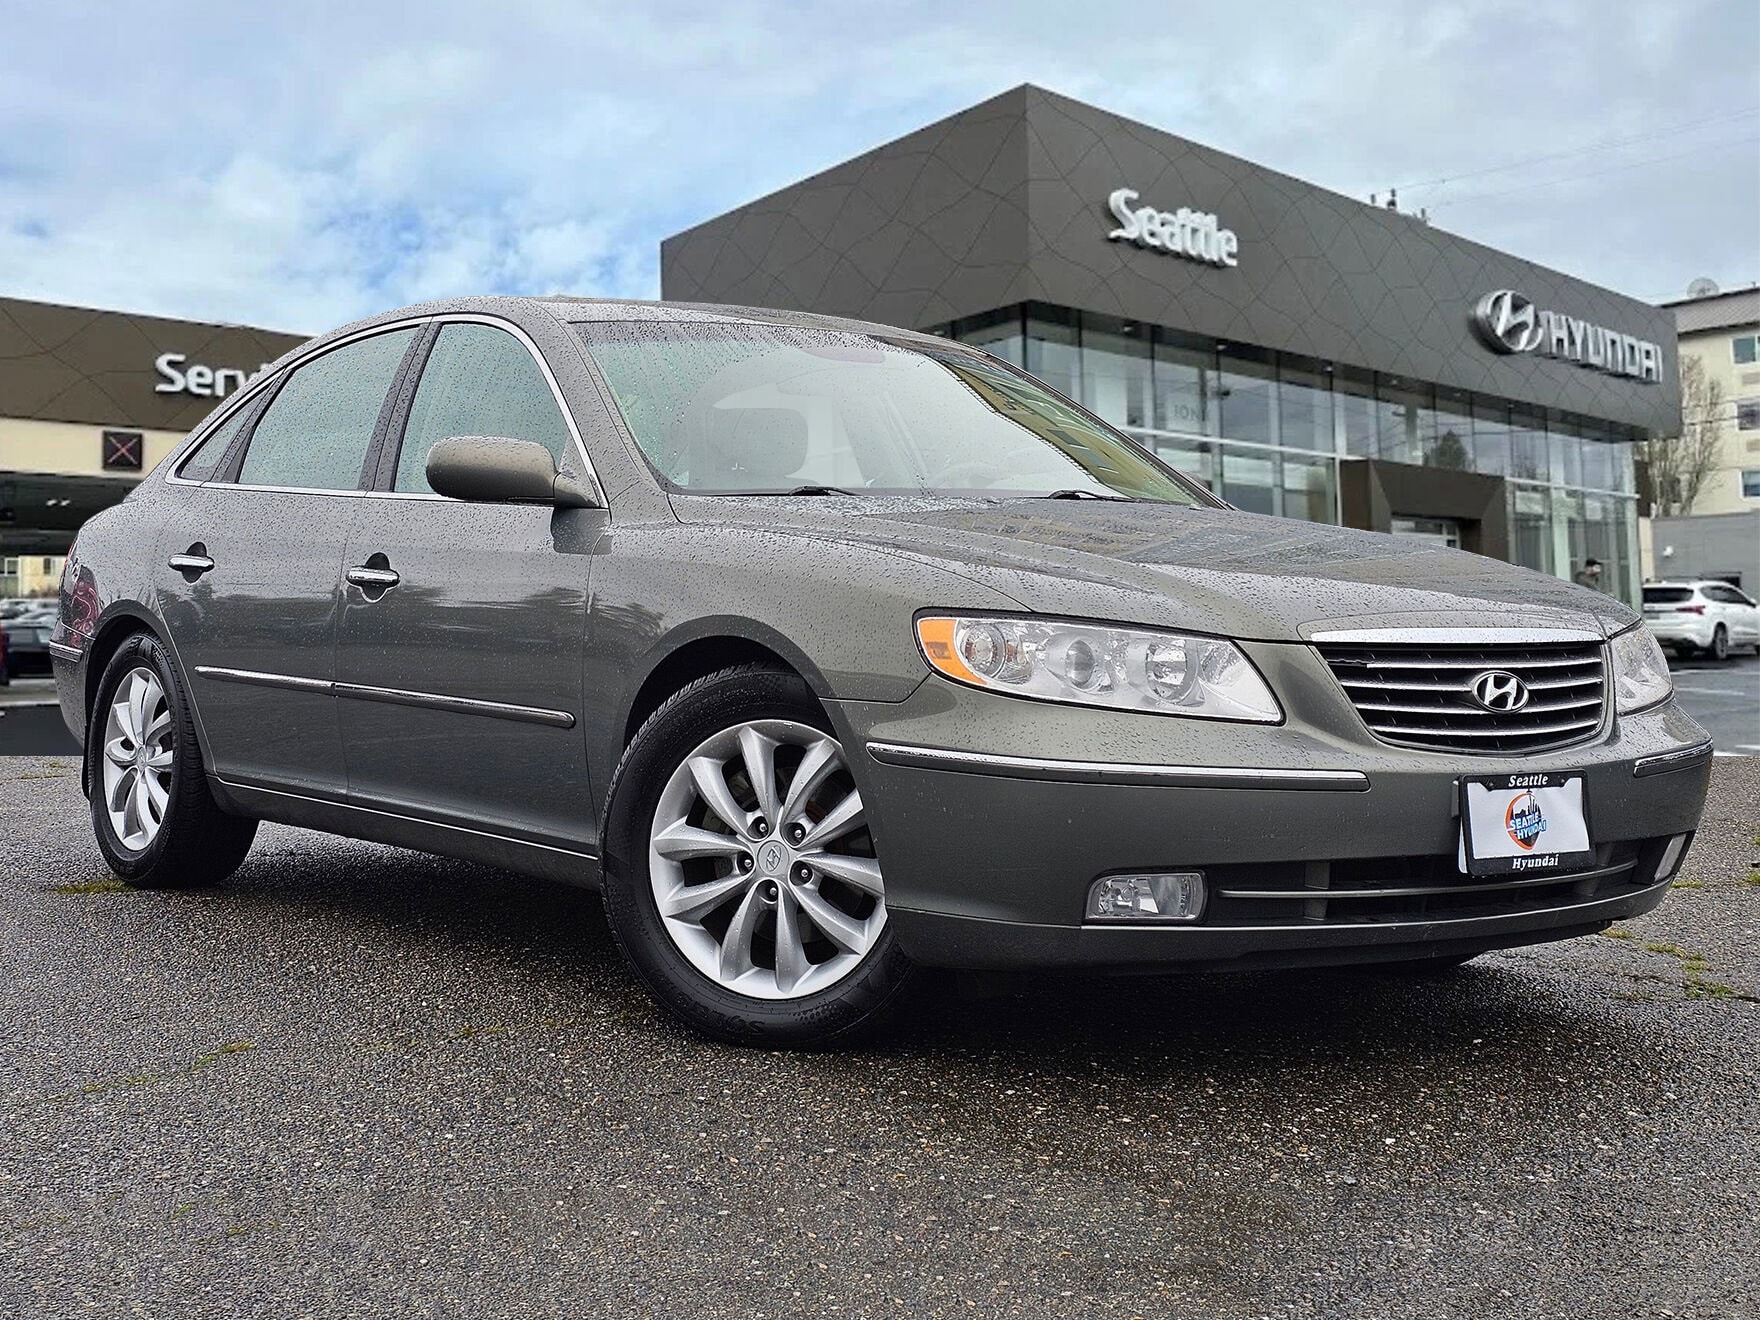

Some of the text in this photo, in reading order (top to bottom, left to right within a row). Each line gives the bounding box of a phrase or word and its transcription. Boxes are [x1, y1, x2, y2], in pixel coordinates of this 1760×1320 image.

[1109, 188, 1238, 267] Seattle
[1540, 311, 1663, 382] HYUNDAI
[155, 352, 273, 397] Serv
[1508, 774, 1549, 787] Seattle
[1512, 854, 1560, 871] Hyundai
